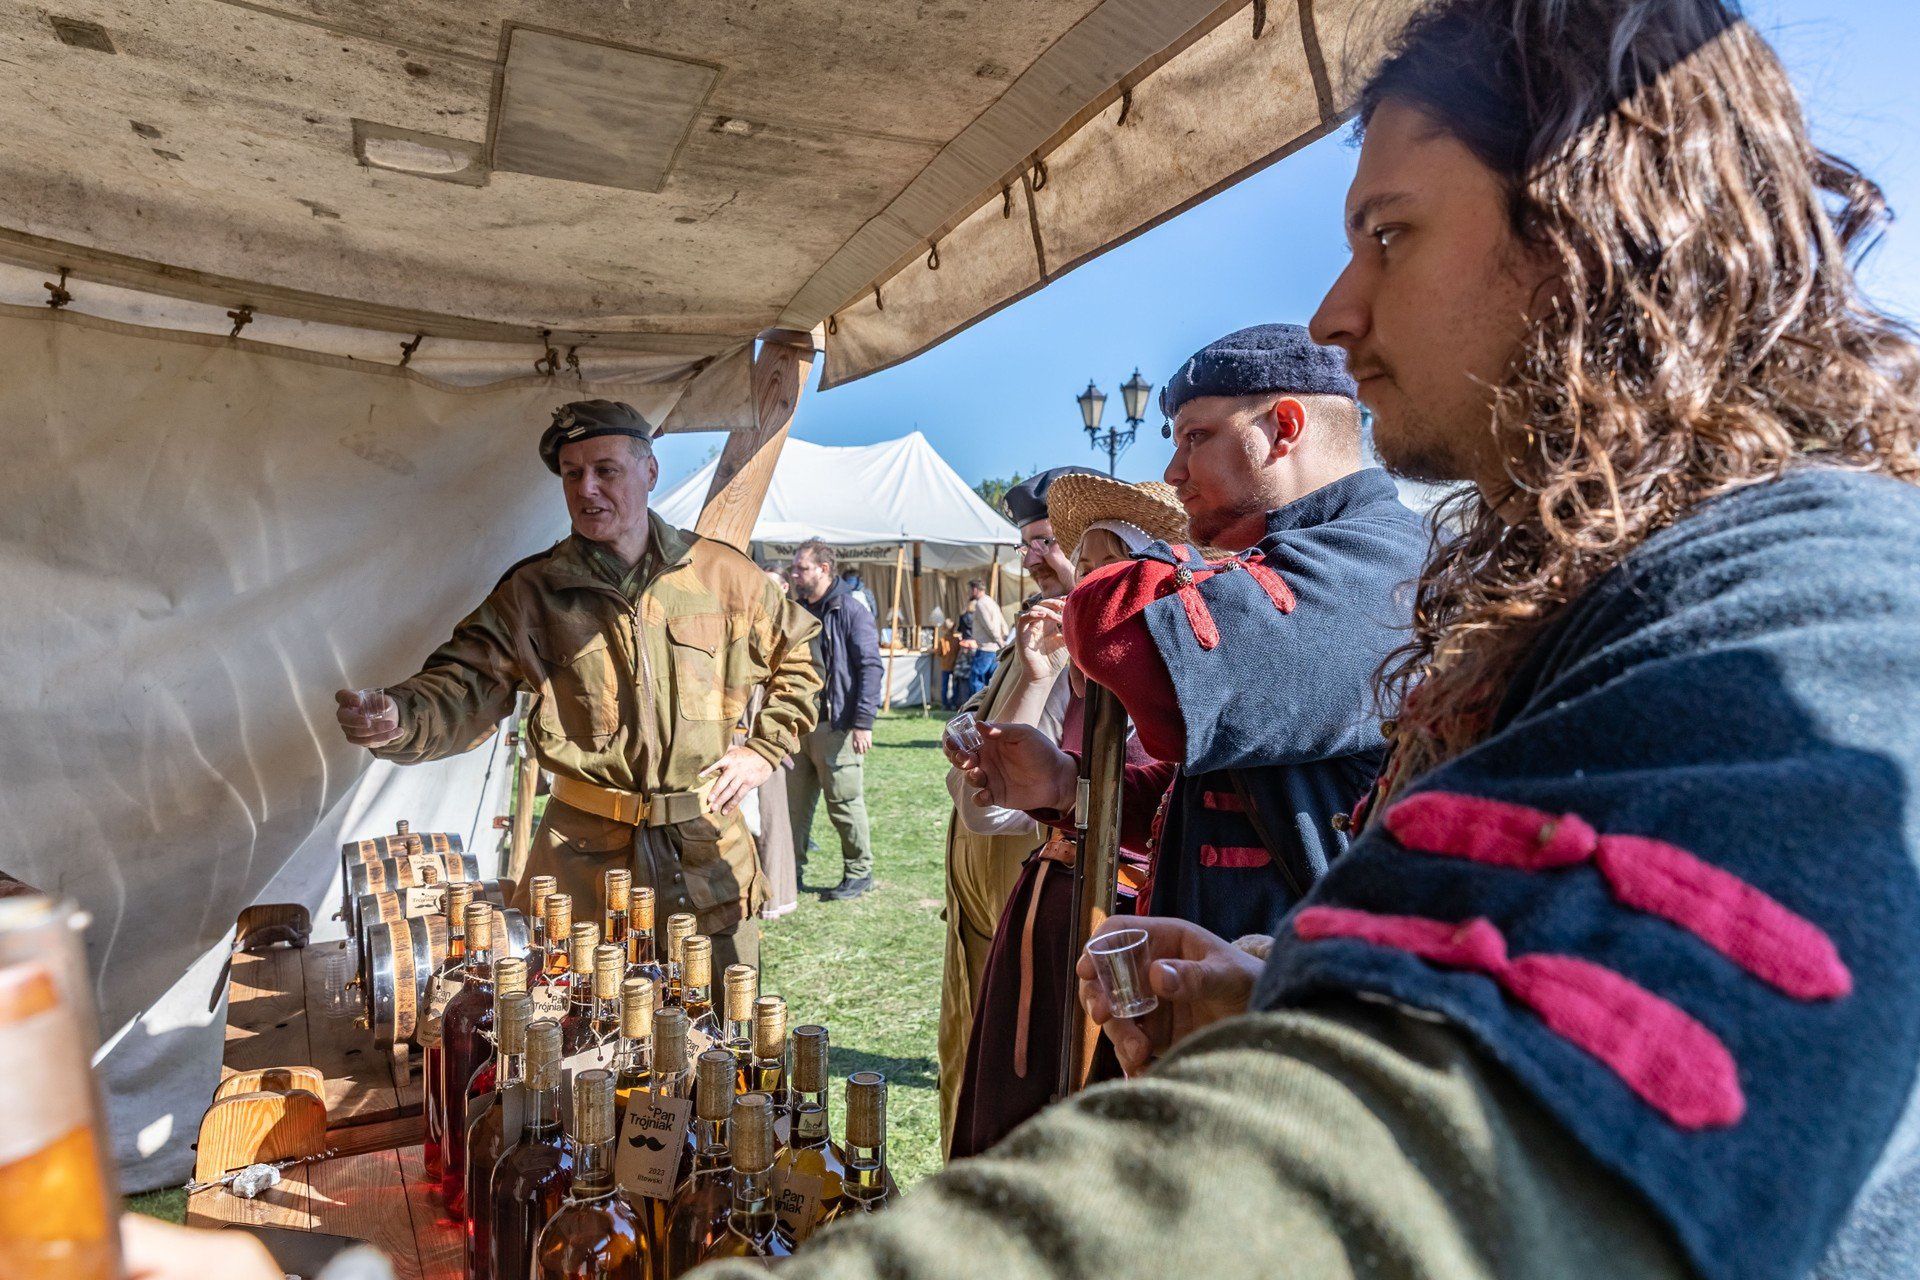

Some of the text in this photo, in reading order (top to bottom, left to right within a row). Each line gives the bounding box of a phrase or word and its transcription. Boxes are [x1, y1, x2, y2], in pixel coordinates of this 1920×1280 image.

[551, 995, 568, 1007] Pan
[629, 1112, 673, 1131] Trójniak
[653, 1107, 676, 1122] Pan
[648, 1167, 665, 1182] 2023
[782, 1188, 805, 1204] Pan
